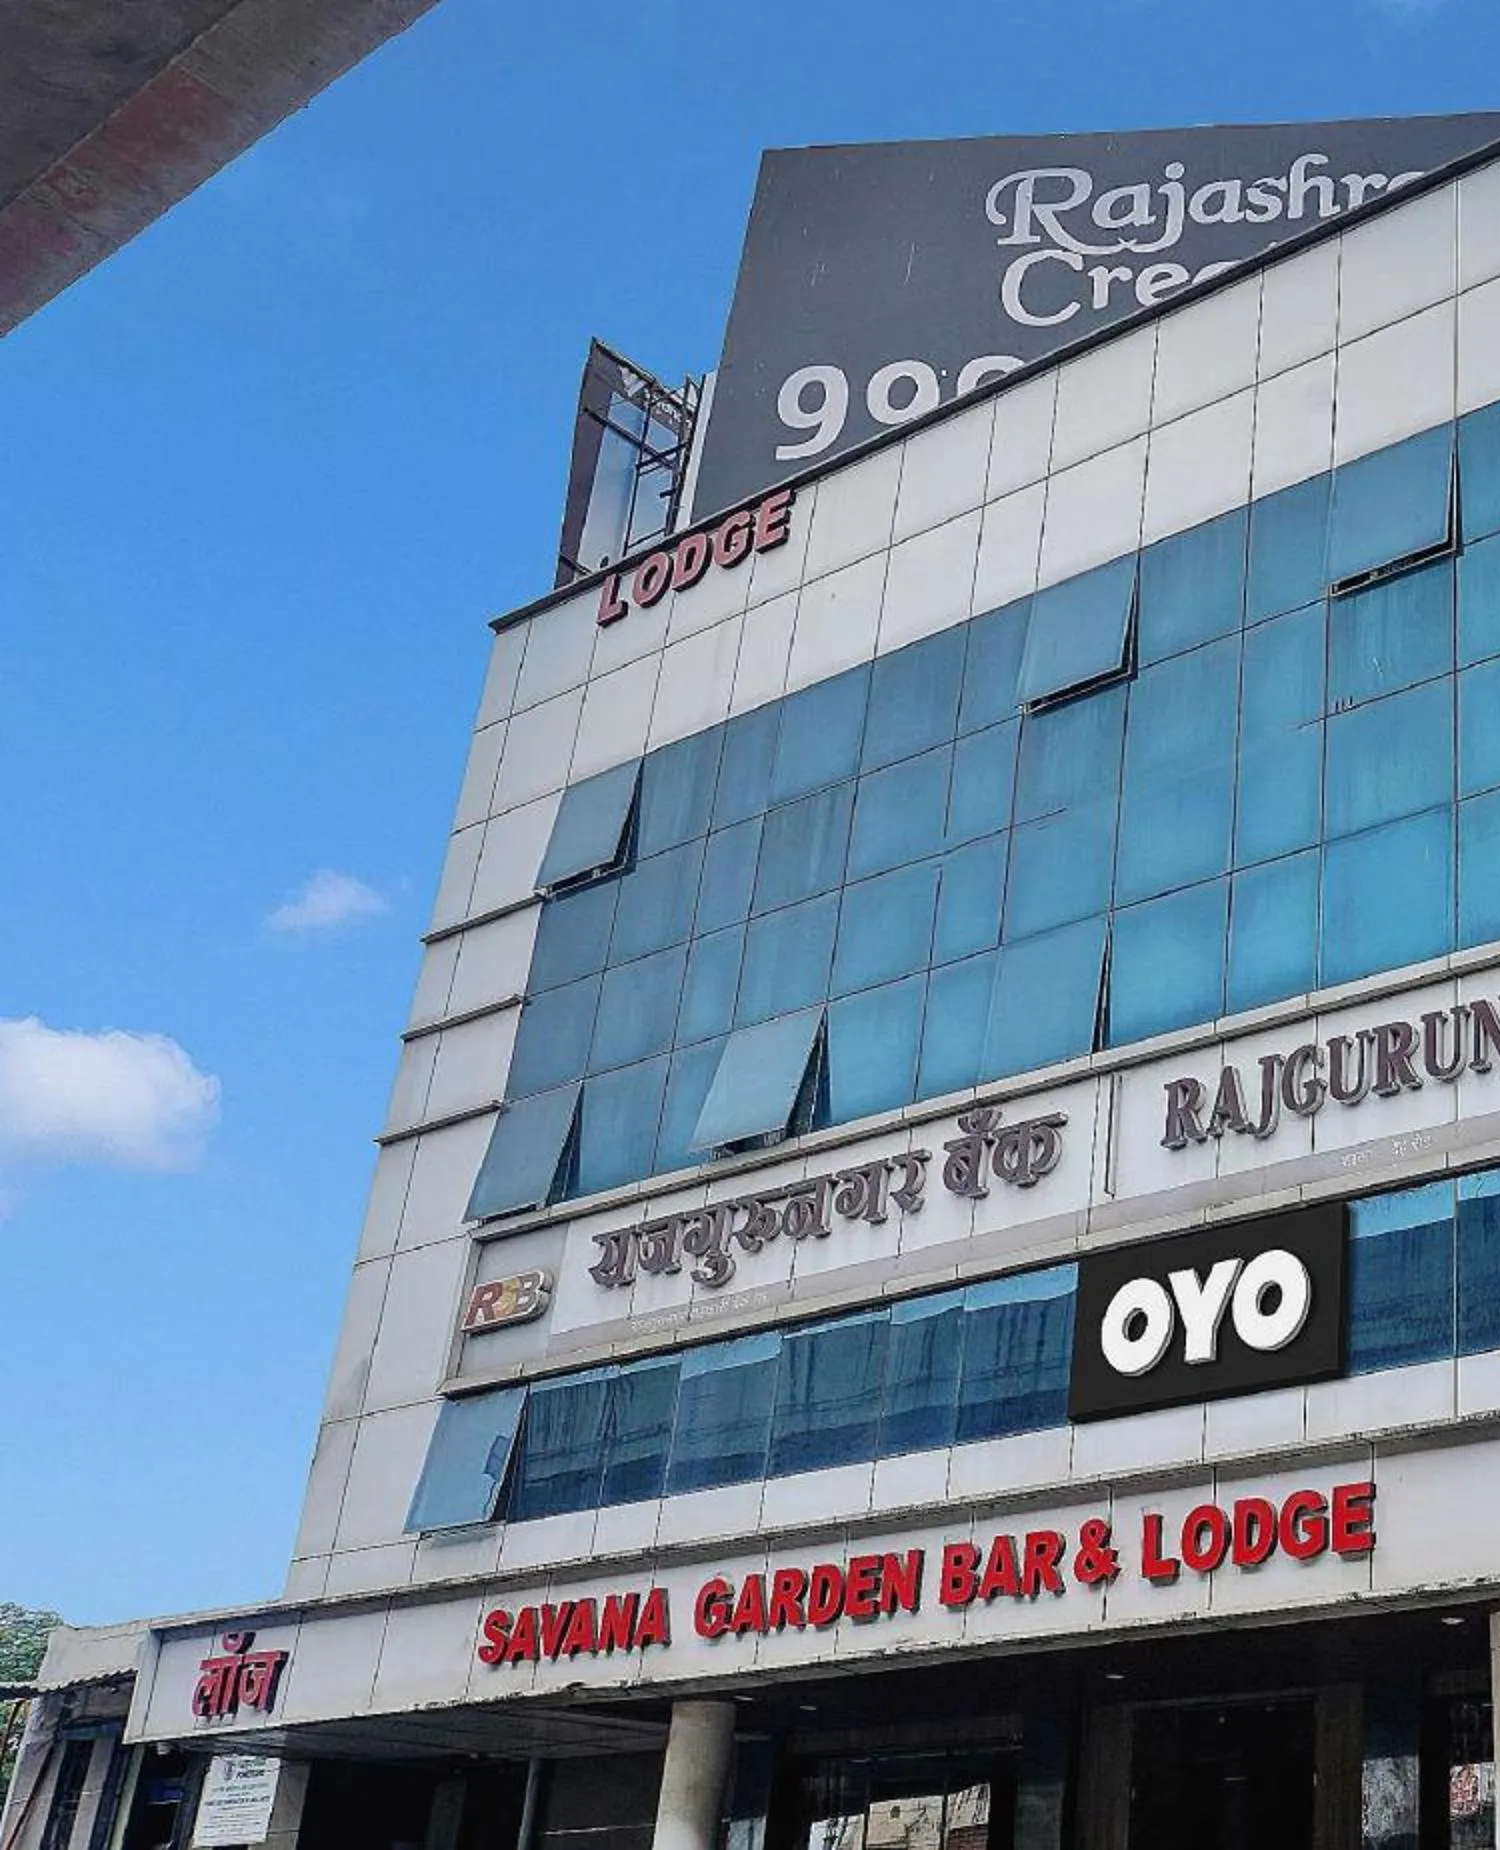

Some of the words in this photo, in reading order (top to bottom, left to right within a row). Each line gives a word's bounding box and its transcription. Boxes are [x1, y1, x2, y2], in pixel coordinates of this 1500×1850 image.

[598, 489, 796, 627] LODGE
[1101, 1249, 1311, 1377] OYO
[477, 1587, 673, 1666] SAVANA
[692, 1548, 925, 1638] GARDEN
[938, 1530, 1067, 1605] BAR
[1073, 1518, 1119, 1584] &
[1141, 1481, 1376, 1583] LODGE
